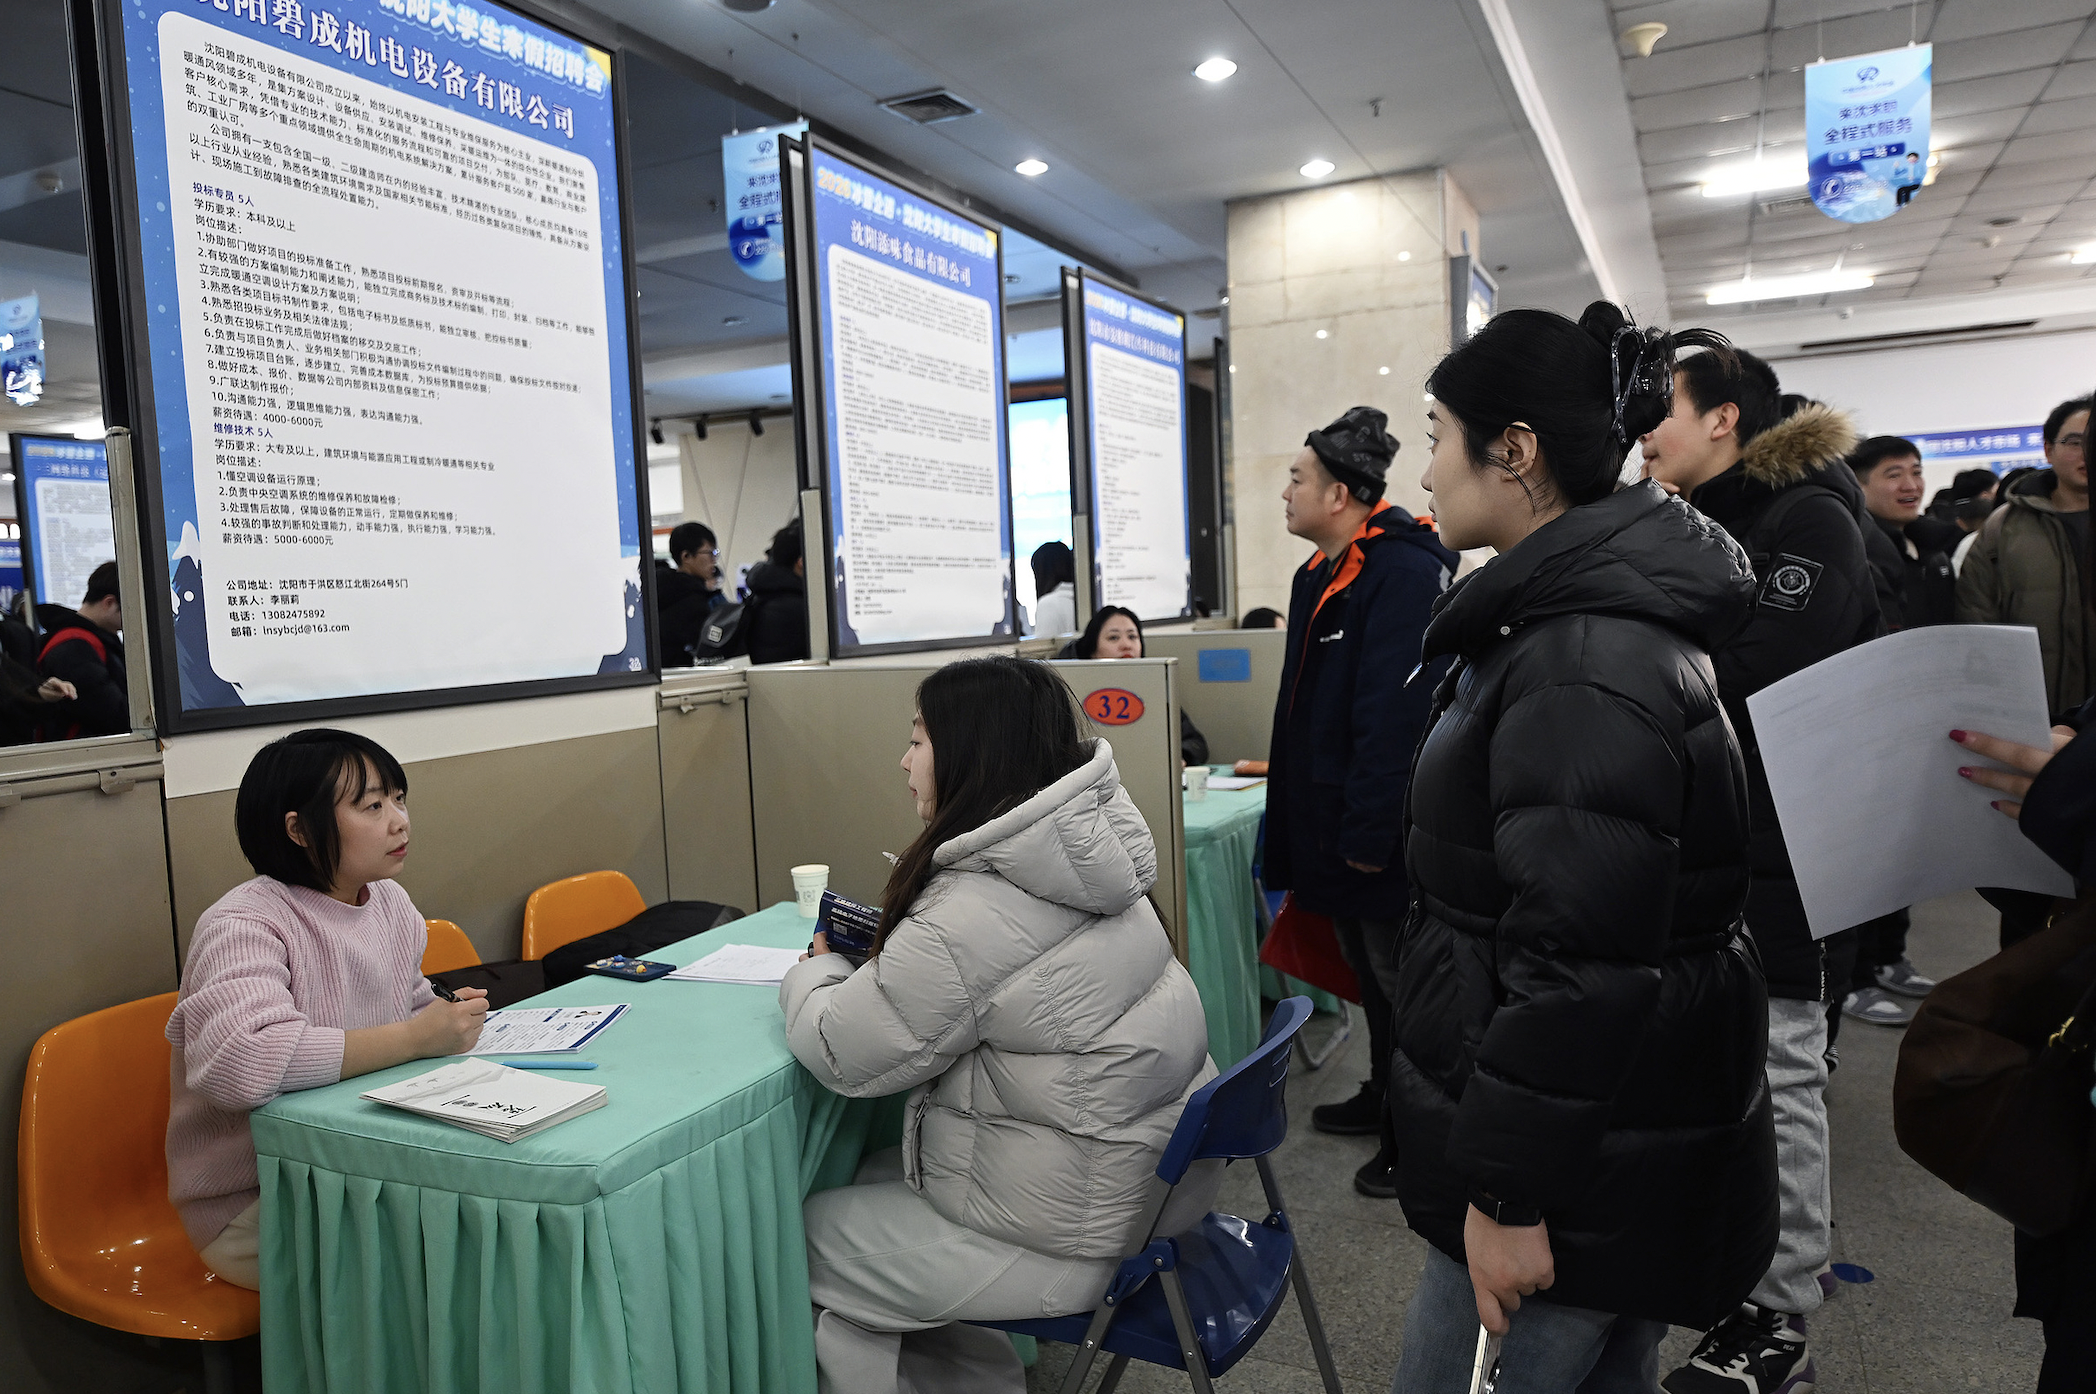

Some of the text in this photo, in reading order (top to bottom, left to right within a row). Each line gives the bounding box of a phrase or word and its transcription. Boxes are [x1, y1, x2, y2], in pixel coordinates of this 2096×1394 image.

[197, 0, 574, 139] 阳碧成机电设备有限公司
[186, 99, 243, 127] 的双重认可。
[192, 181, 254, 207] 投标专员 5人
[193, 197, 295, 232] 学历要求：本科及以上
[195, 213, 241, 234] 岗位描述：
[212, 406, 323, 428] 薪资待遇：4000-6000元
[213, 421, 273, 438] 维修技术 5人
[215, 454, 260, 467] 岗位描述：
[222, 532, 333, 545] 薪资待遇：5000-6000元
[228, 608, 325, 621] 电话：13082475892
[1098, 695, 1130, 719] 32
